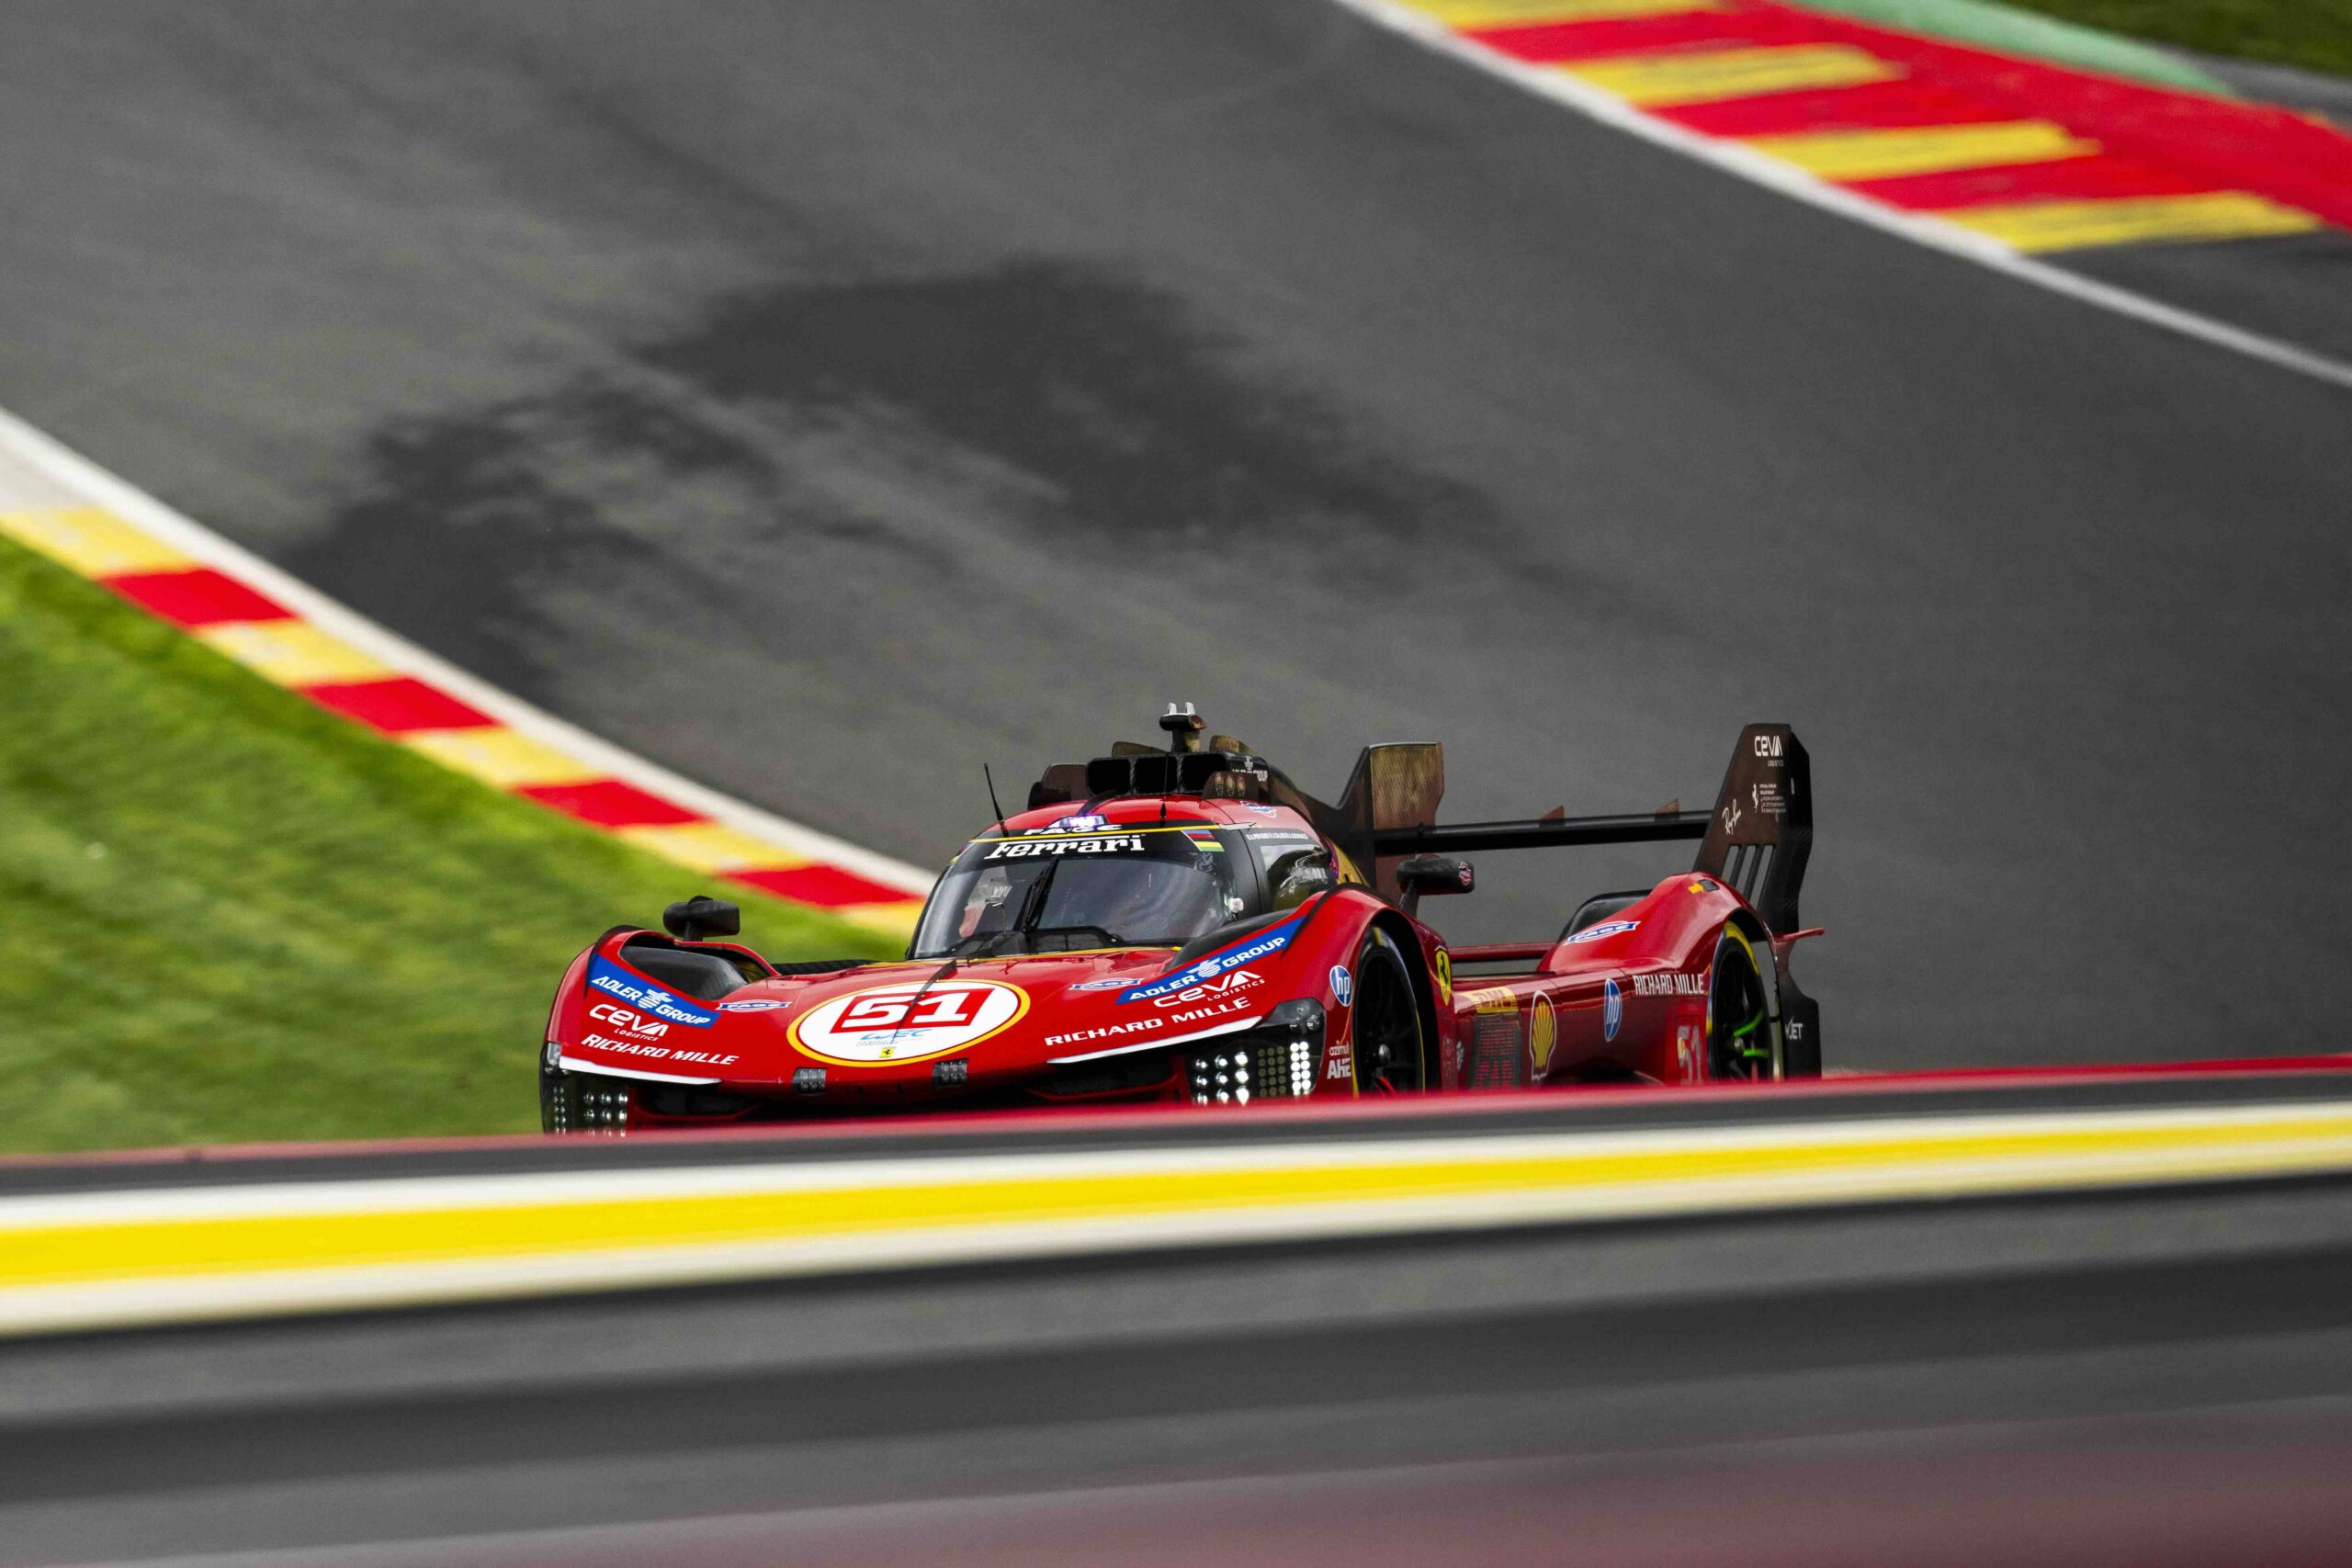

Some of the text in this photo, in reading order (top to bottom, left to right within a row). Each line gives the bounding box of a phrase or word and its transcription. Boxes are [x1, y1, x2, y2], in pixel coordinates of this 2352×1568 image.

[983, 834, 1145, 860] Ferrari
[1129, 937, 1285, 1000] ADLER GROUP
[1335, 966, 1351, 1005] hp
[1632, 974, 1705, 996] RICHARD MILLE
[591, 976, 711, 1025] ADLER GROUP
[1207, 979, 1265, 1001] LOGISTICS
[841, 992, 971, 1028] 51
[1045, 997, 1251, 1046] RICHARD MILLE
[1606, 981, 1620, 1039] hp
[581, 1033, 740, 1066] RICHARD MILLE
[614, 1028, 660, 1042] LOGISTICS
